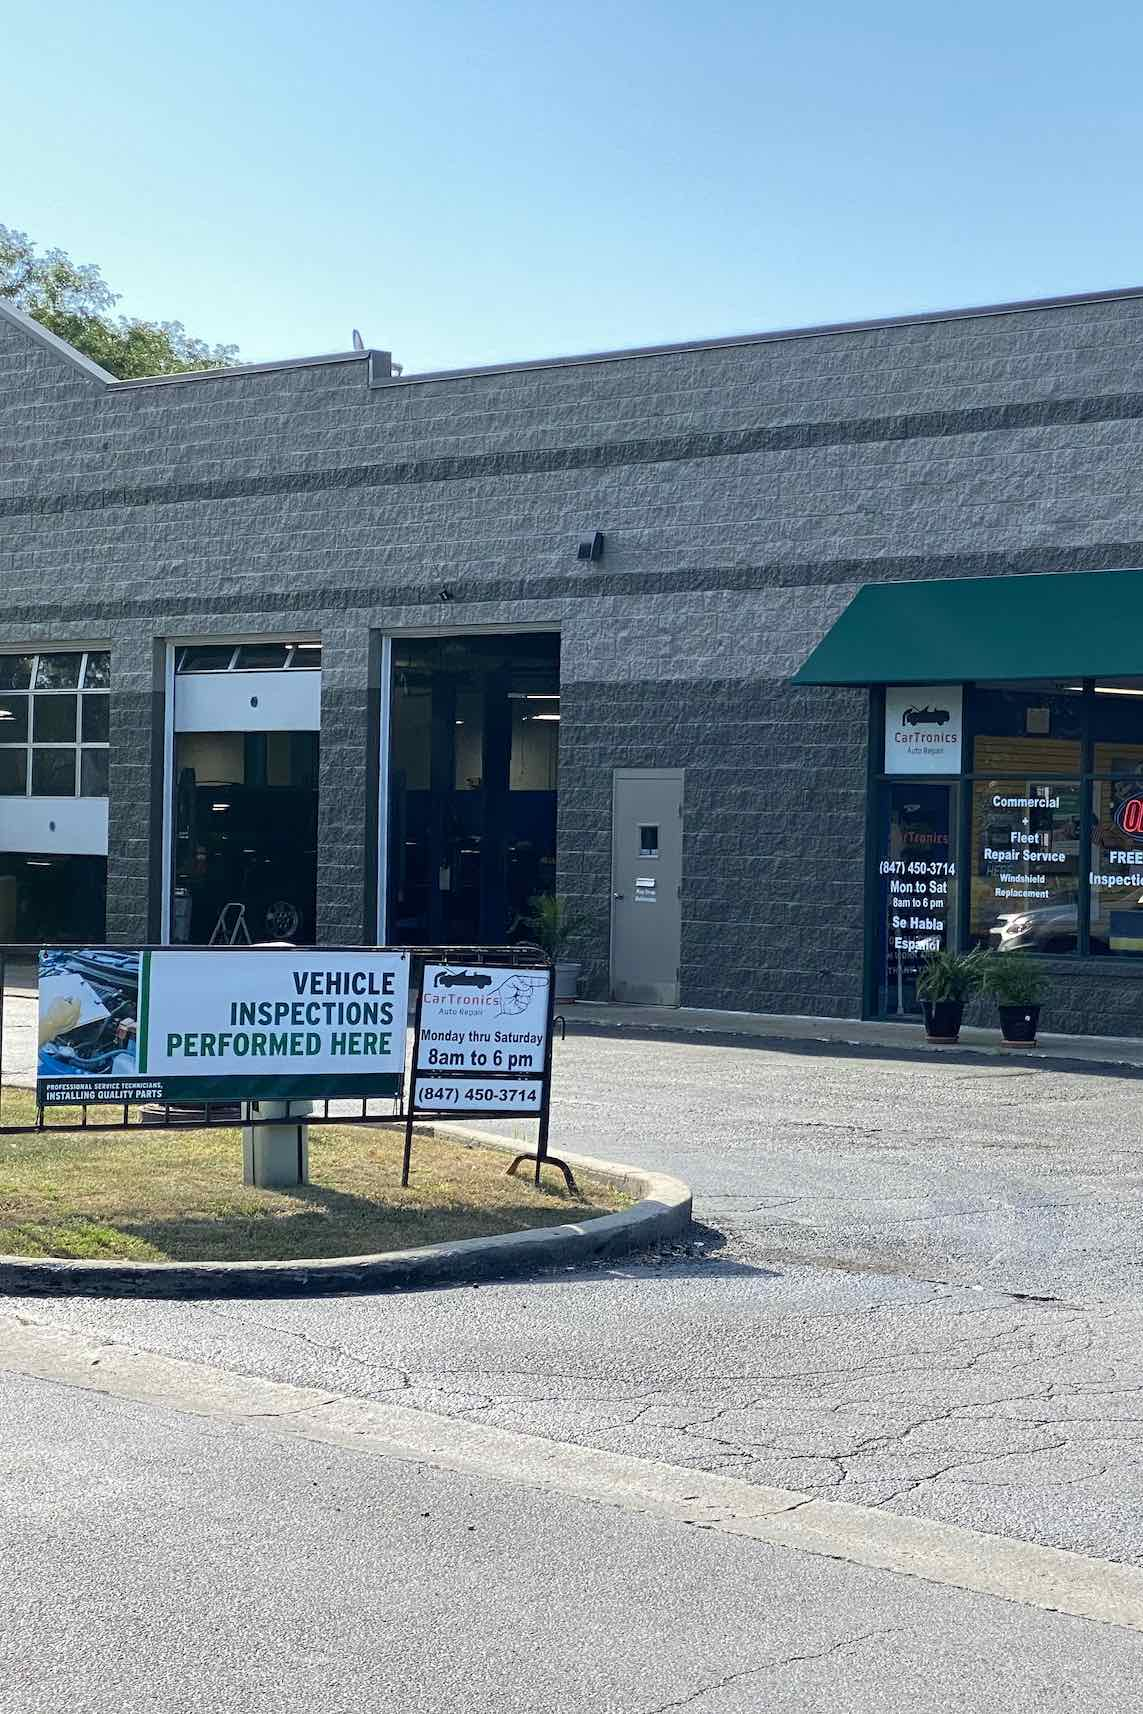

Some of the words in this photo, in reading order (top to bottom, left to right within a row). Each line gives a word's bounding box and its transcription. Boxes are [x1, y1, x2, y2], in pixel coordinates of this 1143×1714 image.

[894, 731, 957, 743] CarTronics
[992, 795, 1060, 808] Commercial
[1010, 831, 1040, 844] Fleet
[984, 848, 1020, 862] Repair
[1022, 849, 1065, 863] Service
[1109, 851, 1143, 864] FREE
[879, 861, 905, 875] (847)
[908, 862, 955, 876] 450-3714
[1000, 873, 1045, 883] Windshield
[890, 880, 913, 893] Mon
[915, 881, 926, 893] to
[929, 880, 947, 894] Sat
[995, 887, 1049, 898] Replacement
[892, 898, 911, 908] 8am
[912, 898, 921, 908] to
[923, 898, 928, 908] 6
[930, 900, 943, 910] pm
[892, 916, 907, 929] Se
[910, 916, 943, 931] Habla
[293, 971, 395, 995] VEHICLE
[423, 993, 500, 1006] CarTronics
[231, 1001, 394, 1026] INSPECTIONS
[438, 1007, 457, 1015] Auto
[167, 1032, 321, 1057] PERFORMED
[330, 1032, 392, 1056] HERE
[421, 1029, 465, 1044] Monday
[468, 1030, 491, 1042] thru
[494, 1031, 543, 1047] Saturday
[428, 1048, 464, 1065] 8am
[470, 1050, 487, 1066] to
[493, 1049, 503, 1067] 6
[508, 1053, 533, 1071] pm
[46, 1083, 93, 1091] PROFESSIONAL
[94, 1082, 120, 1090] SERVICE
[46, 1090, 95, 1101] INSTALLING
[97, 1089, 133, 1099] QUALITY
[135, 1089, 162, 1099] PARTS
[418, 1087, 459, 1103] (847)
[465, 1088, 537, 1101] 450-3714
